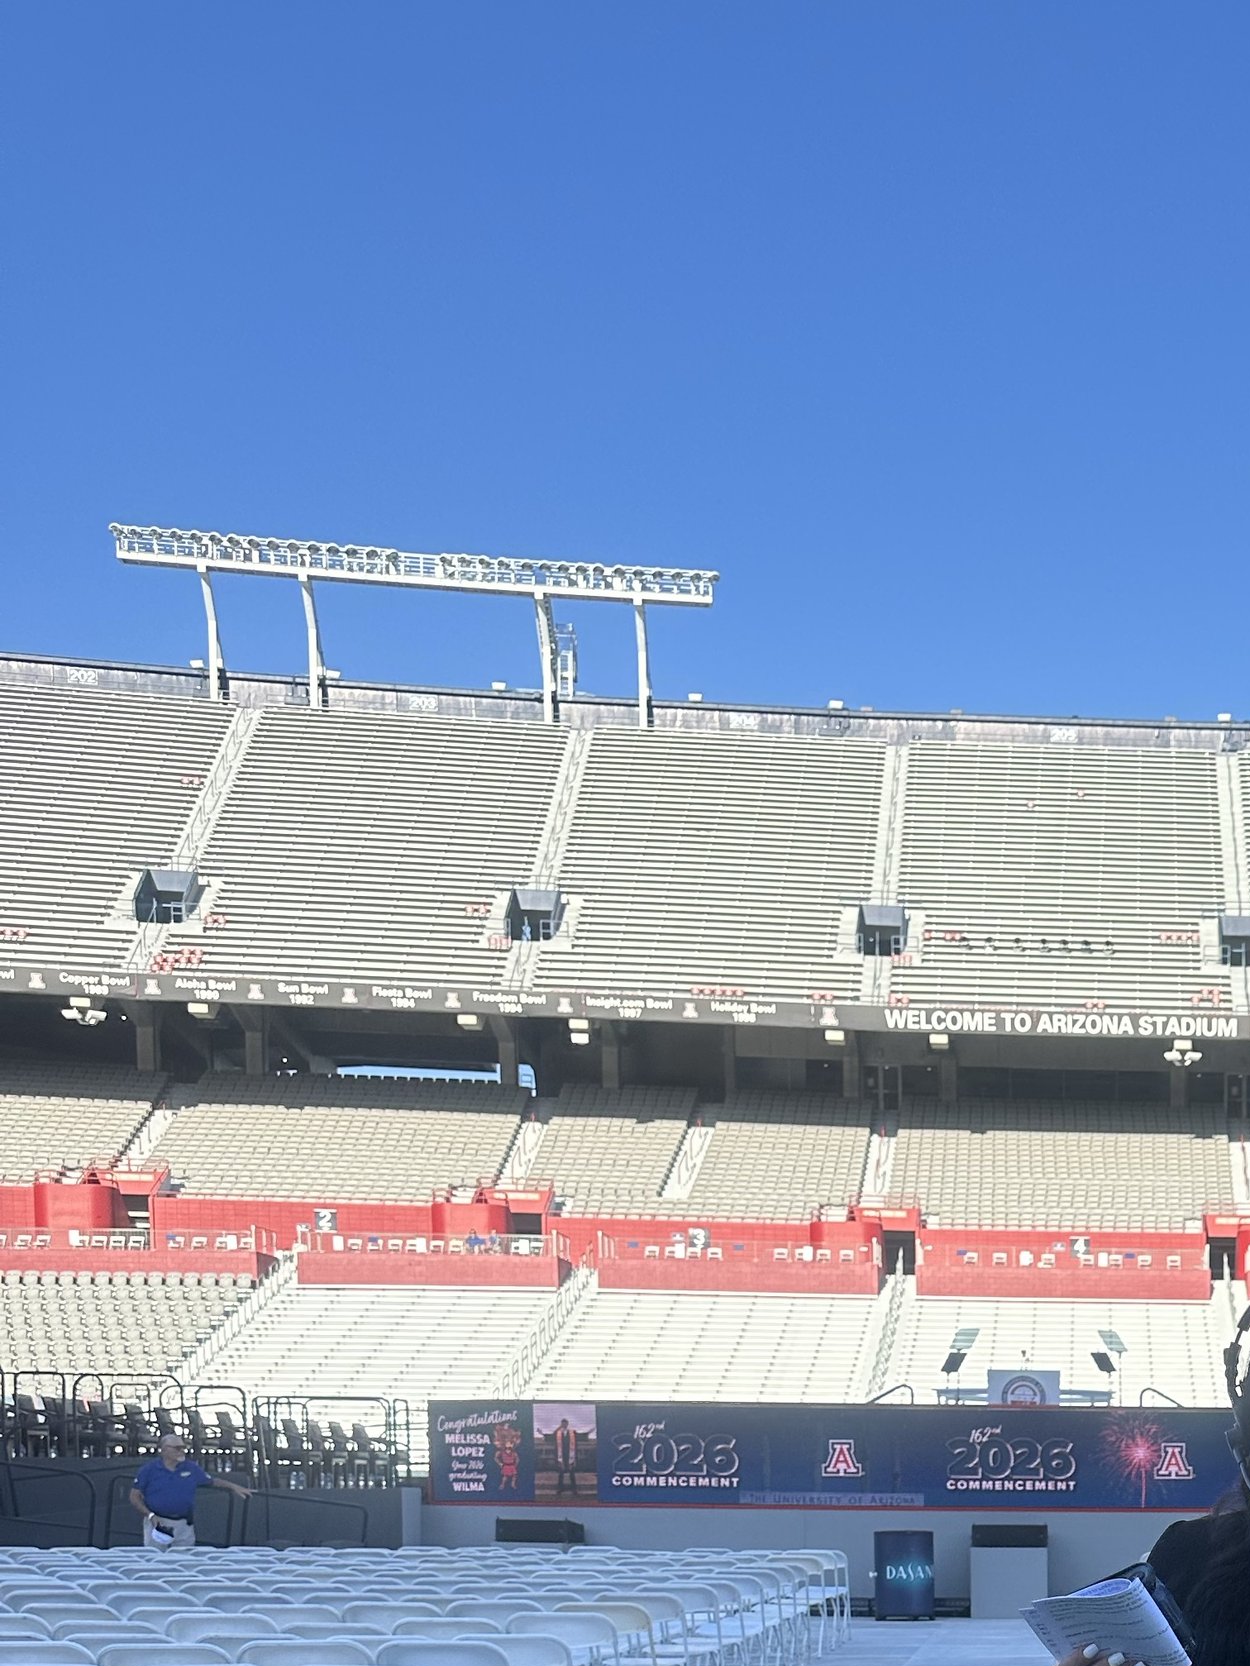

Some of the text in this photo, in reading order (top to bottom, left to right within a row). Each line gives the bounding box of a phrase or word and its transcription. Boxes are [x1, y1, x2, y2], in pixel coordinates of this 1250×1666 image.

[70, 670, 96, 682] 202
[59, 972, 130, 986] Copper Bowl
[175, 978, 236, 991] Aloha Bowl
[278, 982, 328, 994] Sun Bowl
[372, 986, 432, 999] Fiesta Bowl
[473, 991, 546, 1004] Freedom Bowl
[586, 996, 673, 1009] Insight.com Bowl
[711, 1001, 776, 1014] Holiday Bowl
[885, 1010, 1237, 1037] WELCOME TO ARIZONA STADIUM
[318, 1211, 332, 1227] 2
[693, 1228, 706, 1245] 3
[1073, 1237, 1087, 1254] 4
[437, 1410, 518, 1433] Congratulations
[633, 1420, 665, 1439] 162nd
[969, 1424, 1002, 1443] 162nd
[445, 1434, 491, 1445] MELISSA
[451, 1447, 485, 1457] LOPEZ
[611, 1433, 739, 1476] 2026
[945, 1436, 1076, 1480] 2026
[449, 1471, 487, 1482] graduating
[612, 1476, 739, 1488] COMMENCEMENT
[453, 1482, 485, 1492] WILMA
[946, 1480, 1076, 1491] COMMENCEMENT
